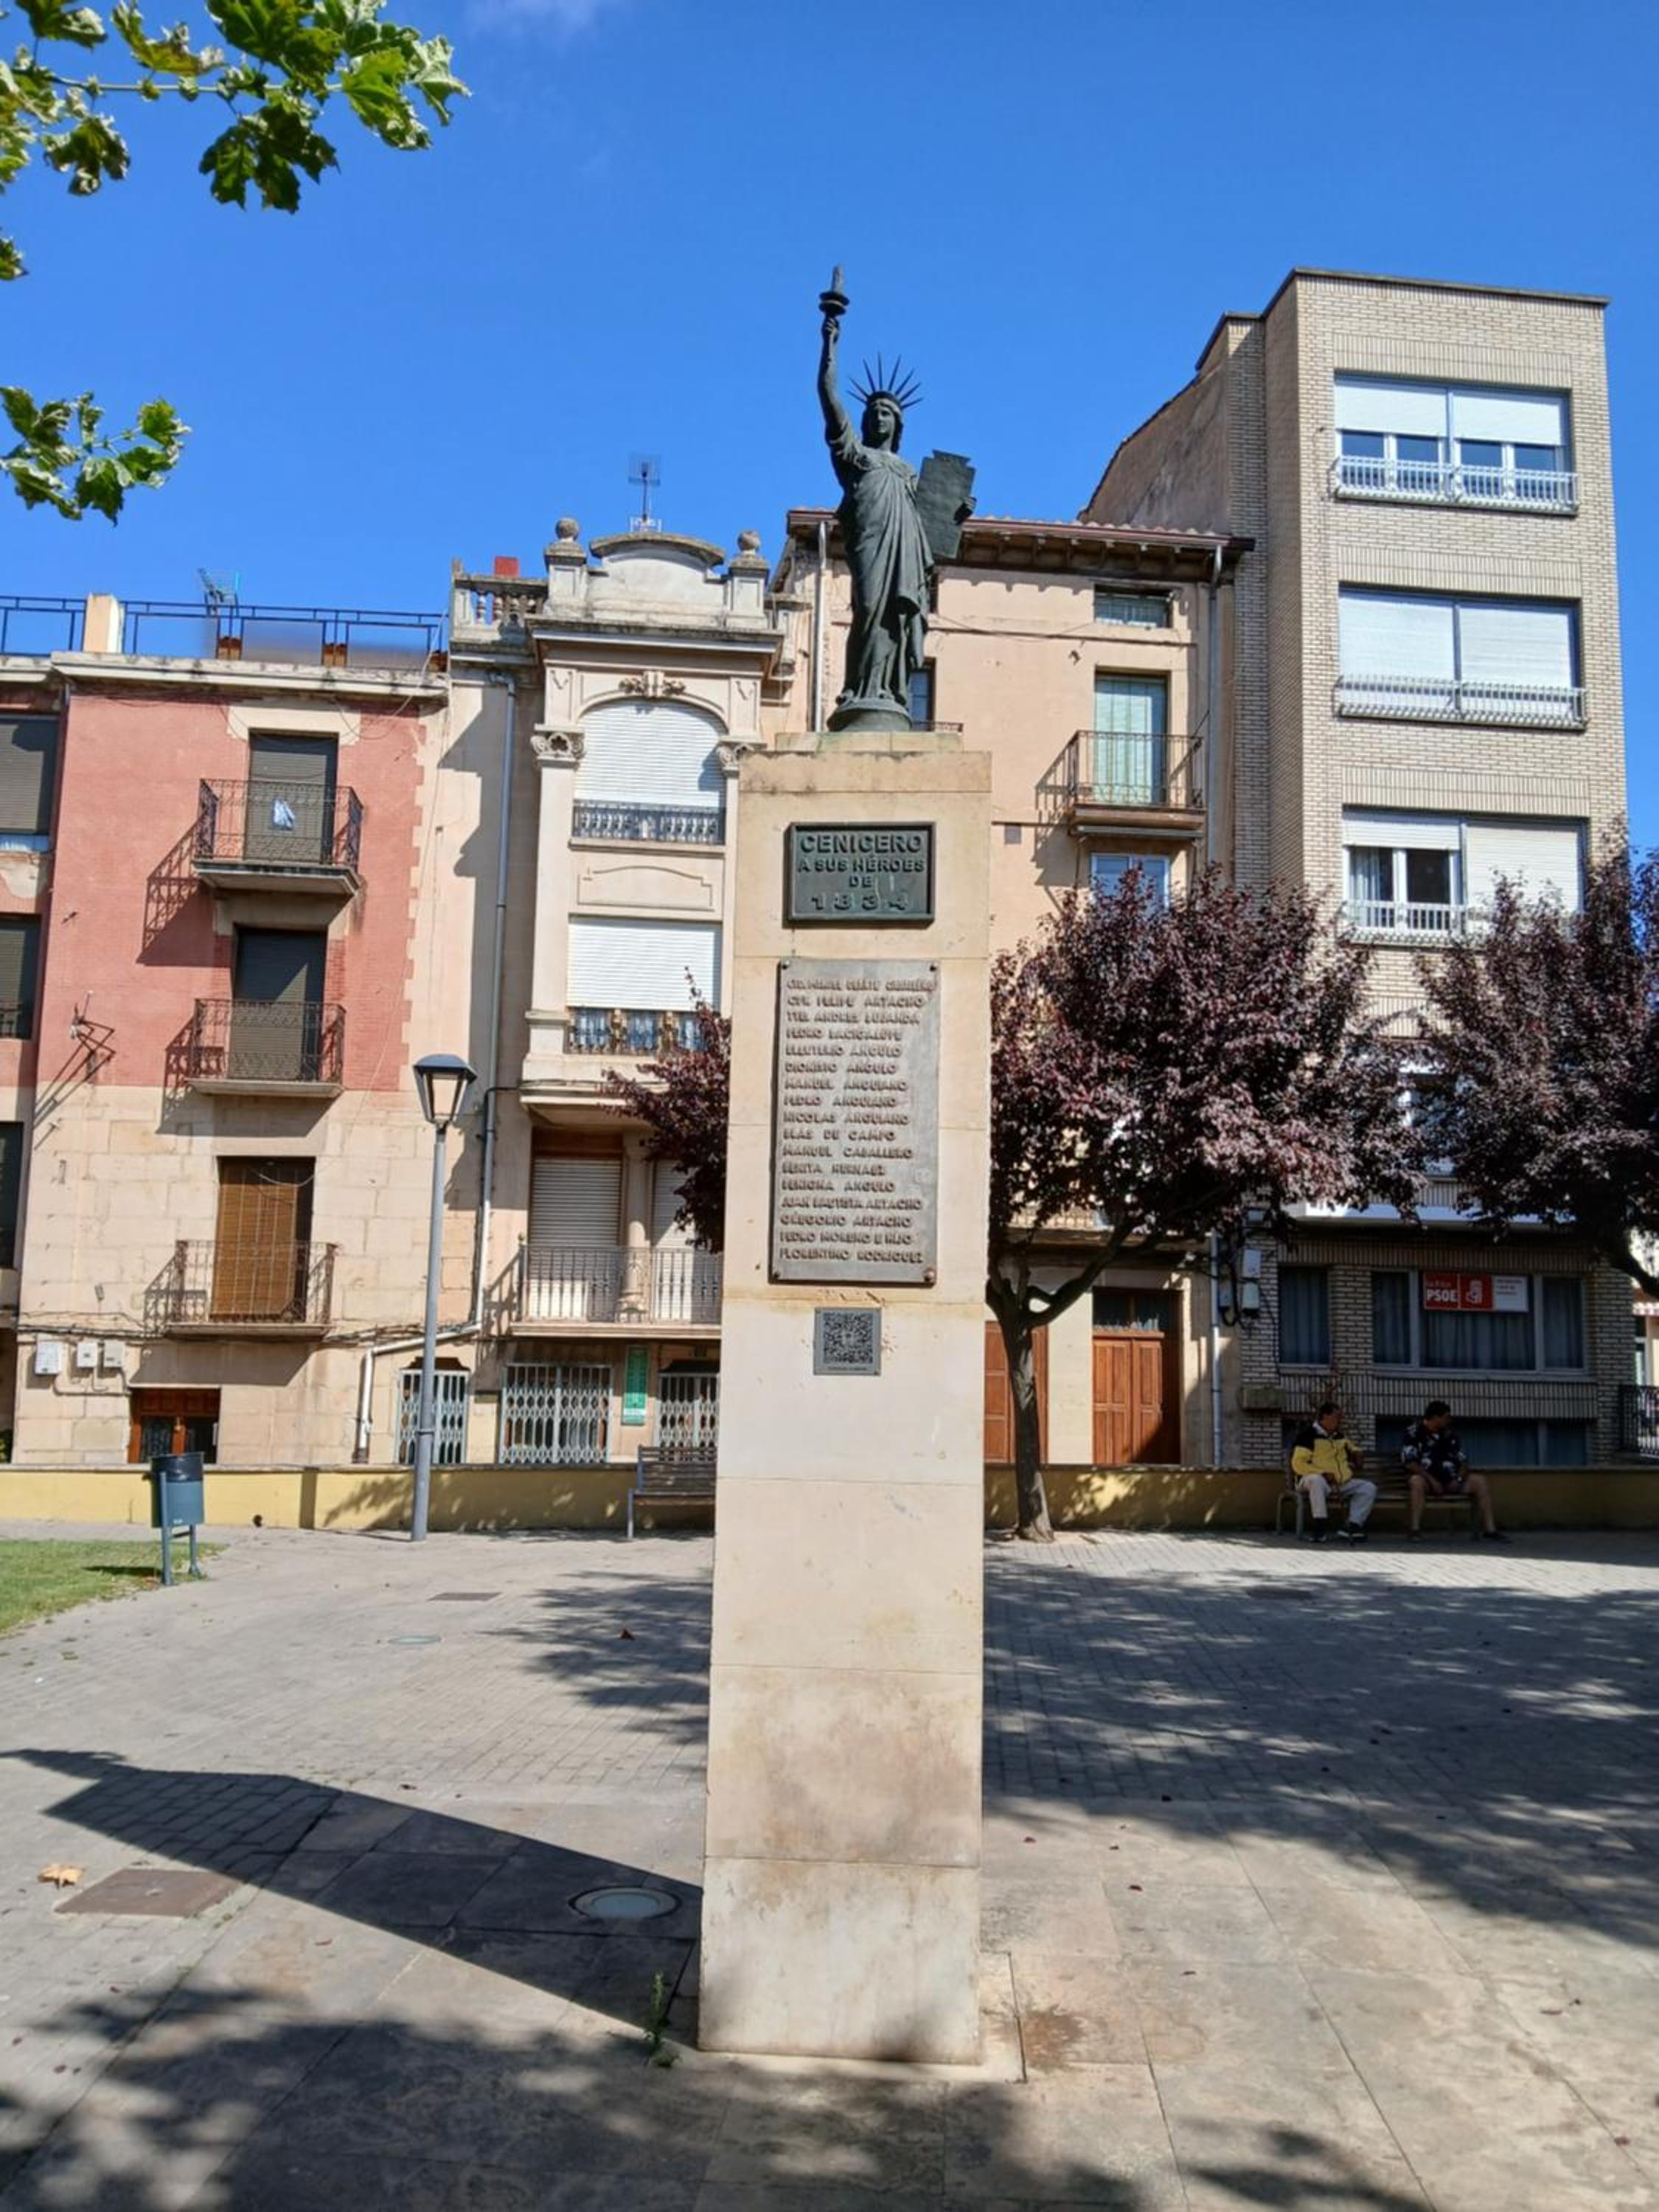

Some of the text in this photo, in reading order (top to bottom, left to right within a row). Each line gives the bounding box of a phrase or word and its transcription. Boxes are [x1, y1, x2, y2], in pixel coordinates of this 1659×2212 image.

[800, 833, 922, 854] CENICERO
[798, 859, 810, 872] A
[815, 859, 847, 872] SUS
[849, 876, 872, 888] DE
[811, 892, 908, 911] 1834
[784, 1079, 835, 1090] MANUEL
[784, 1095, 821, 1106] PEDRO
[782, 1130, 897, 1141] BLAS DE CAMPO
[782, 1146, 832, 1157] MANUEL
[779, 1231, 815, 1242] PEDRO
[1427, 1290, 1458, 1302] PSOE
